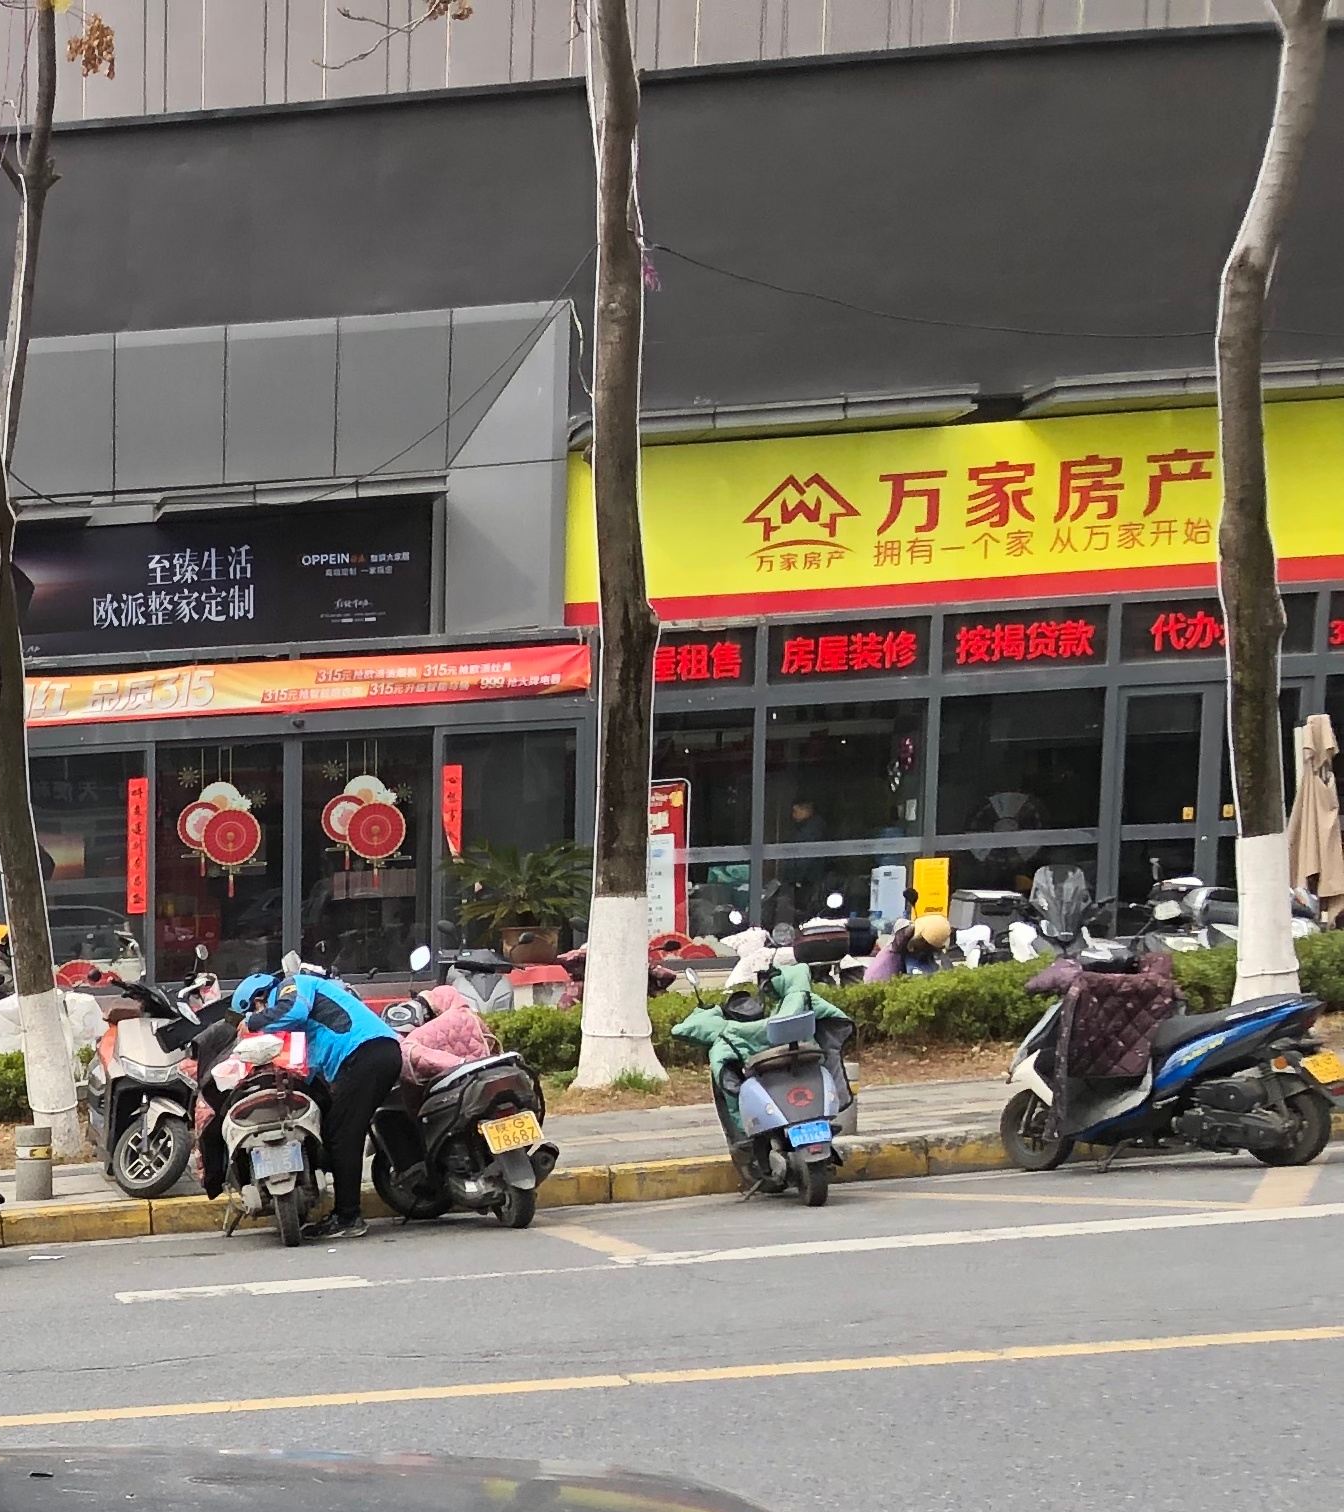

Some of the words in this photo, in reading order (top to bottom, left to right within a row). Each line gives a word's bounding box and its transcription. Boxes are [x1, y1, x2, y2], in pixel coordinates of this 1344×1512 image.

[876, 447, 1216, 537] 万家房产
[301, 552, 350, 566] OPPEIN
[756, 550, 846, 573] 万家房产
[873, 529, 1034, 568] 拥有一个家
[1049, 517, 1215, 554] 从万家开始
[147, 544, 254, 586] 至臻生活
[92, 584, 255, 629] 欧派整家定制
[781, 630, 919, 674] 房屋装修
[955, 618, 1097, 665] 按揭贷款
[1150, 610, 1227, 653] 代办
